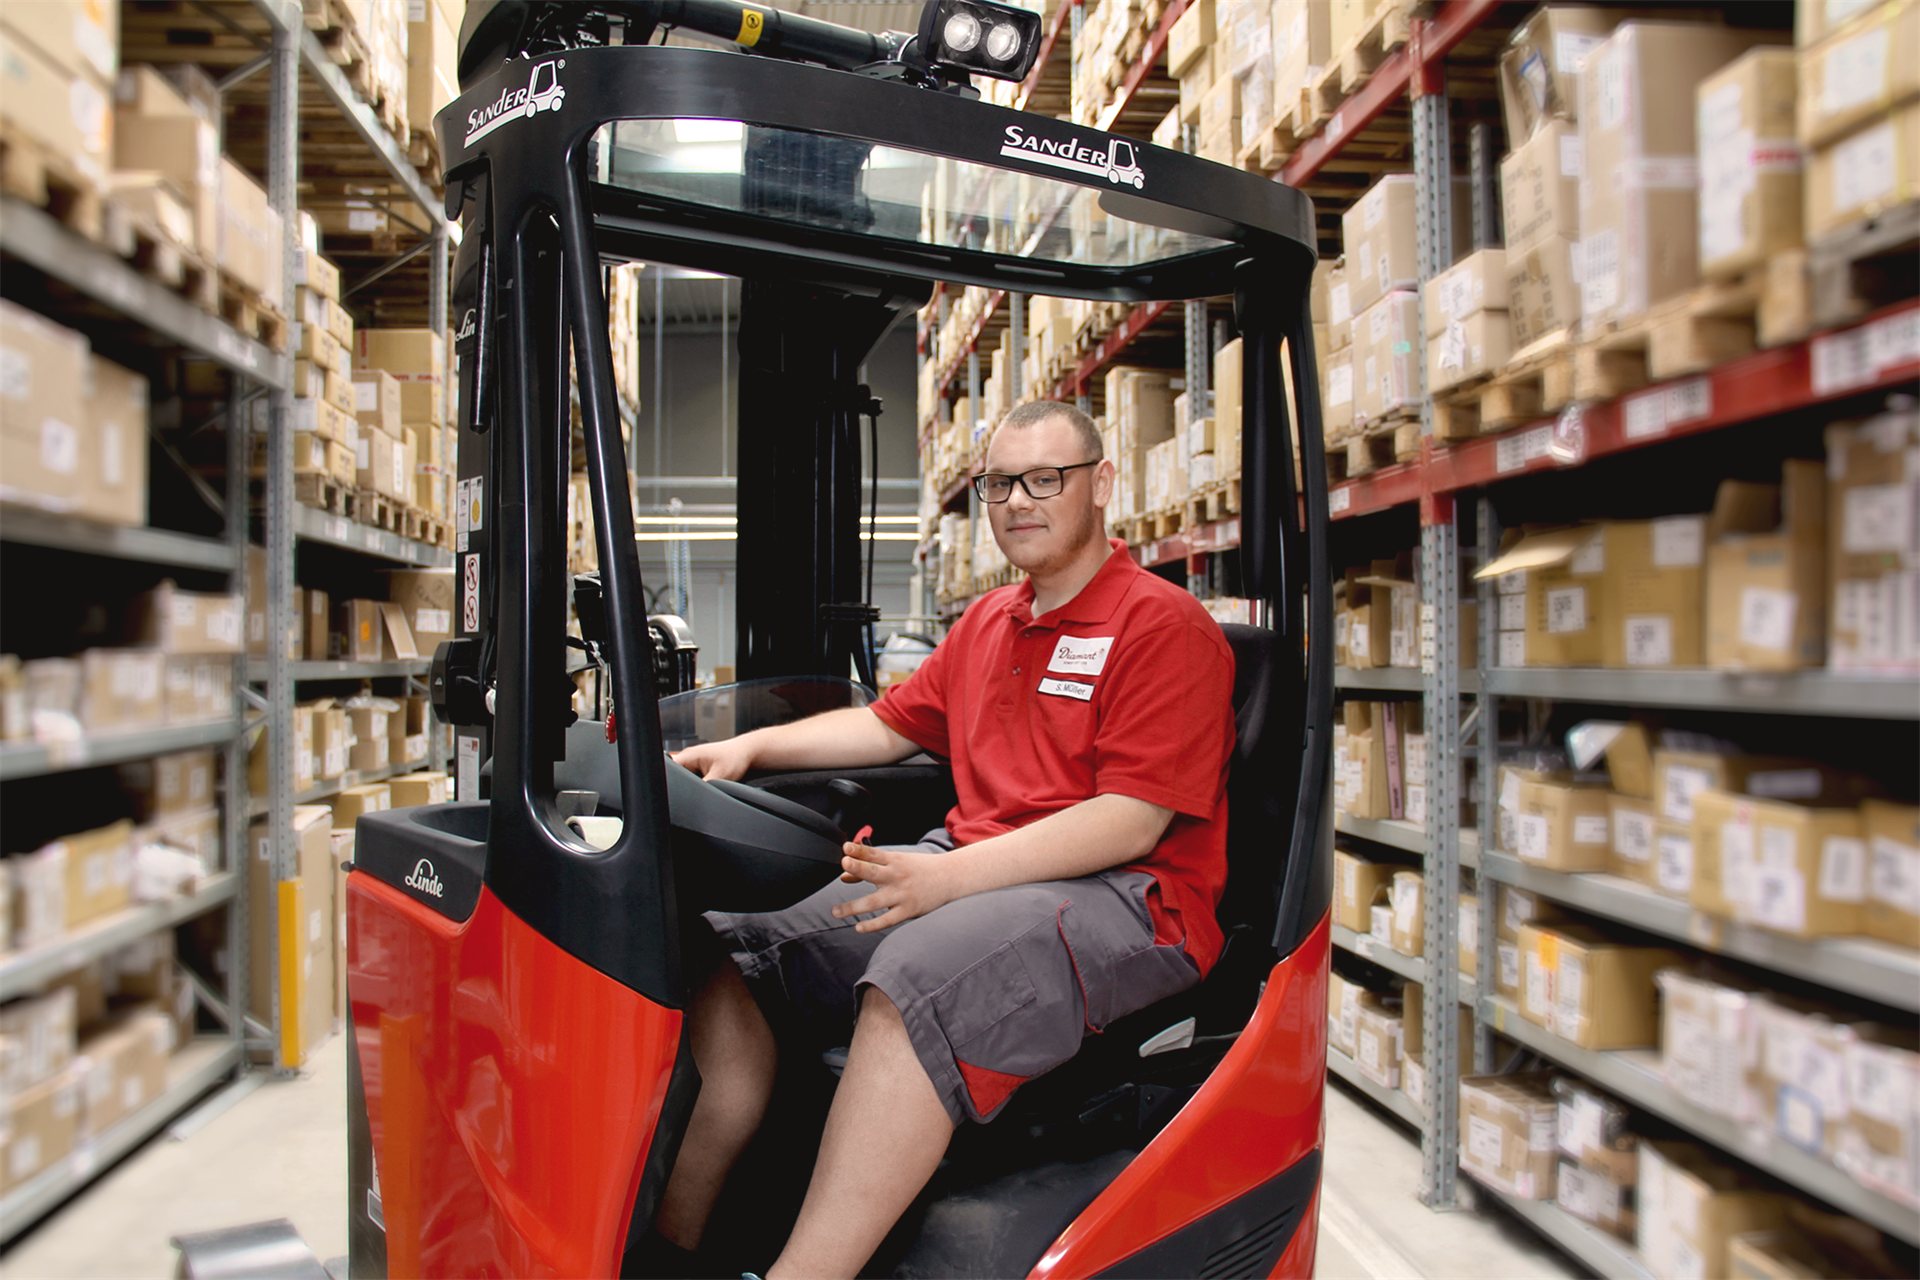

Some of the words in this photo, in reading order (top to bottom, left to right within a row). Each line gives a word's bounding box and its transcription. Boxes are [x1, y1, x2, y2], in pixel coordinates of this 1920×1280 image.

[455, 308, 476, 342] Lin
[1063, 683, 1086, 696] Müller
[405, 858, 444, 898] Linde
